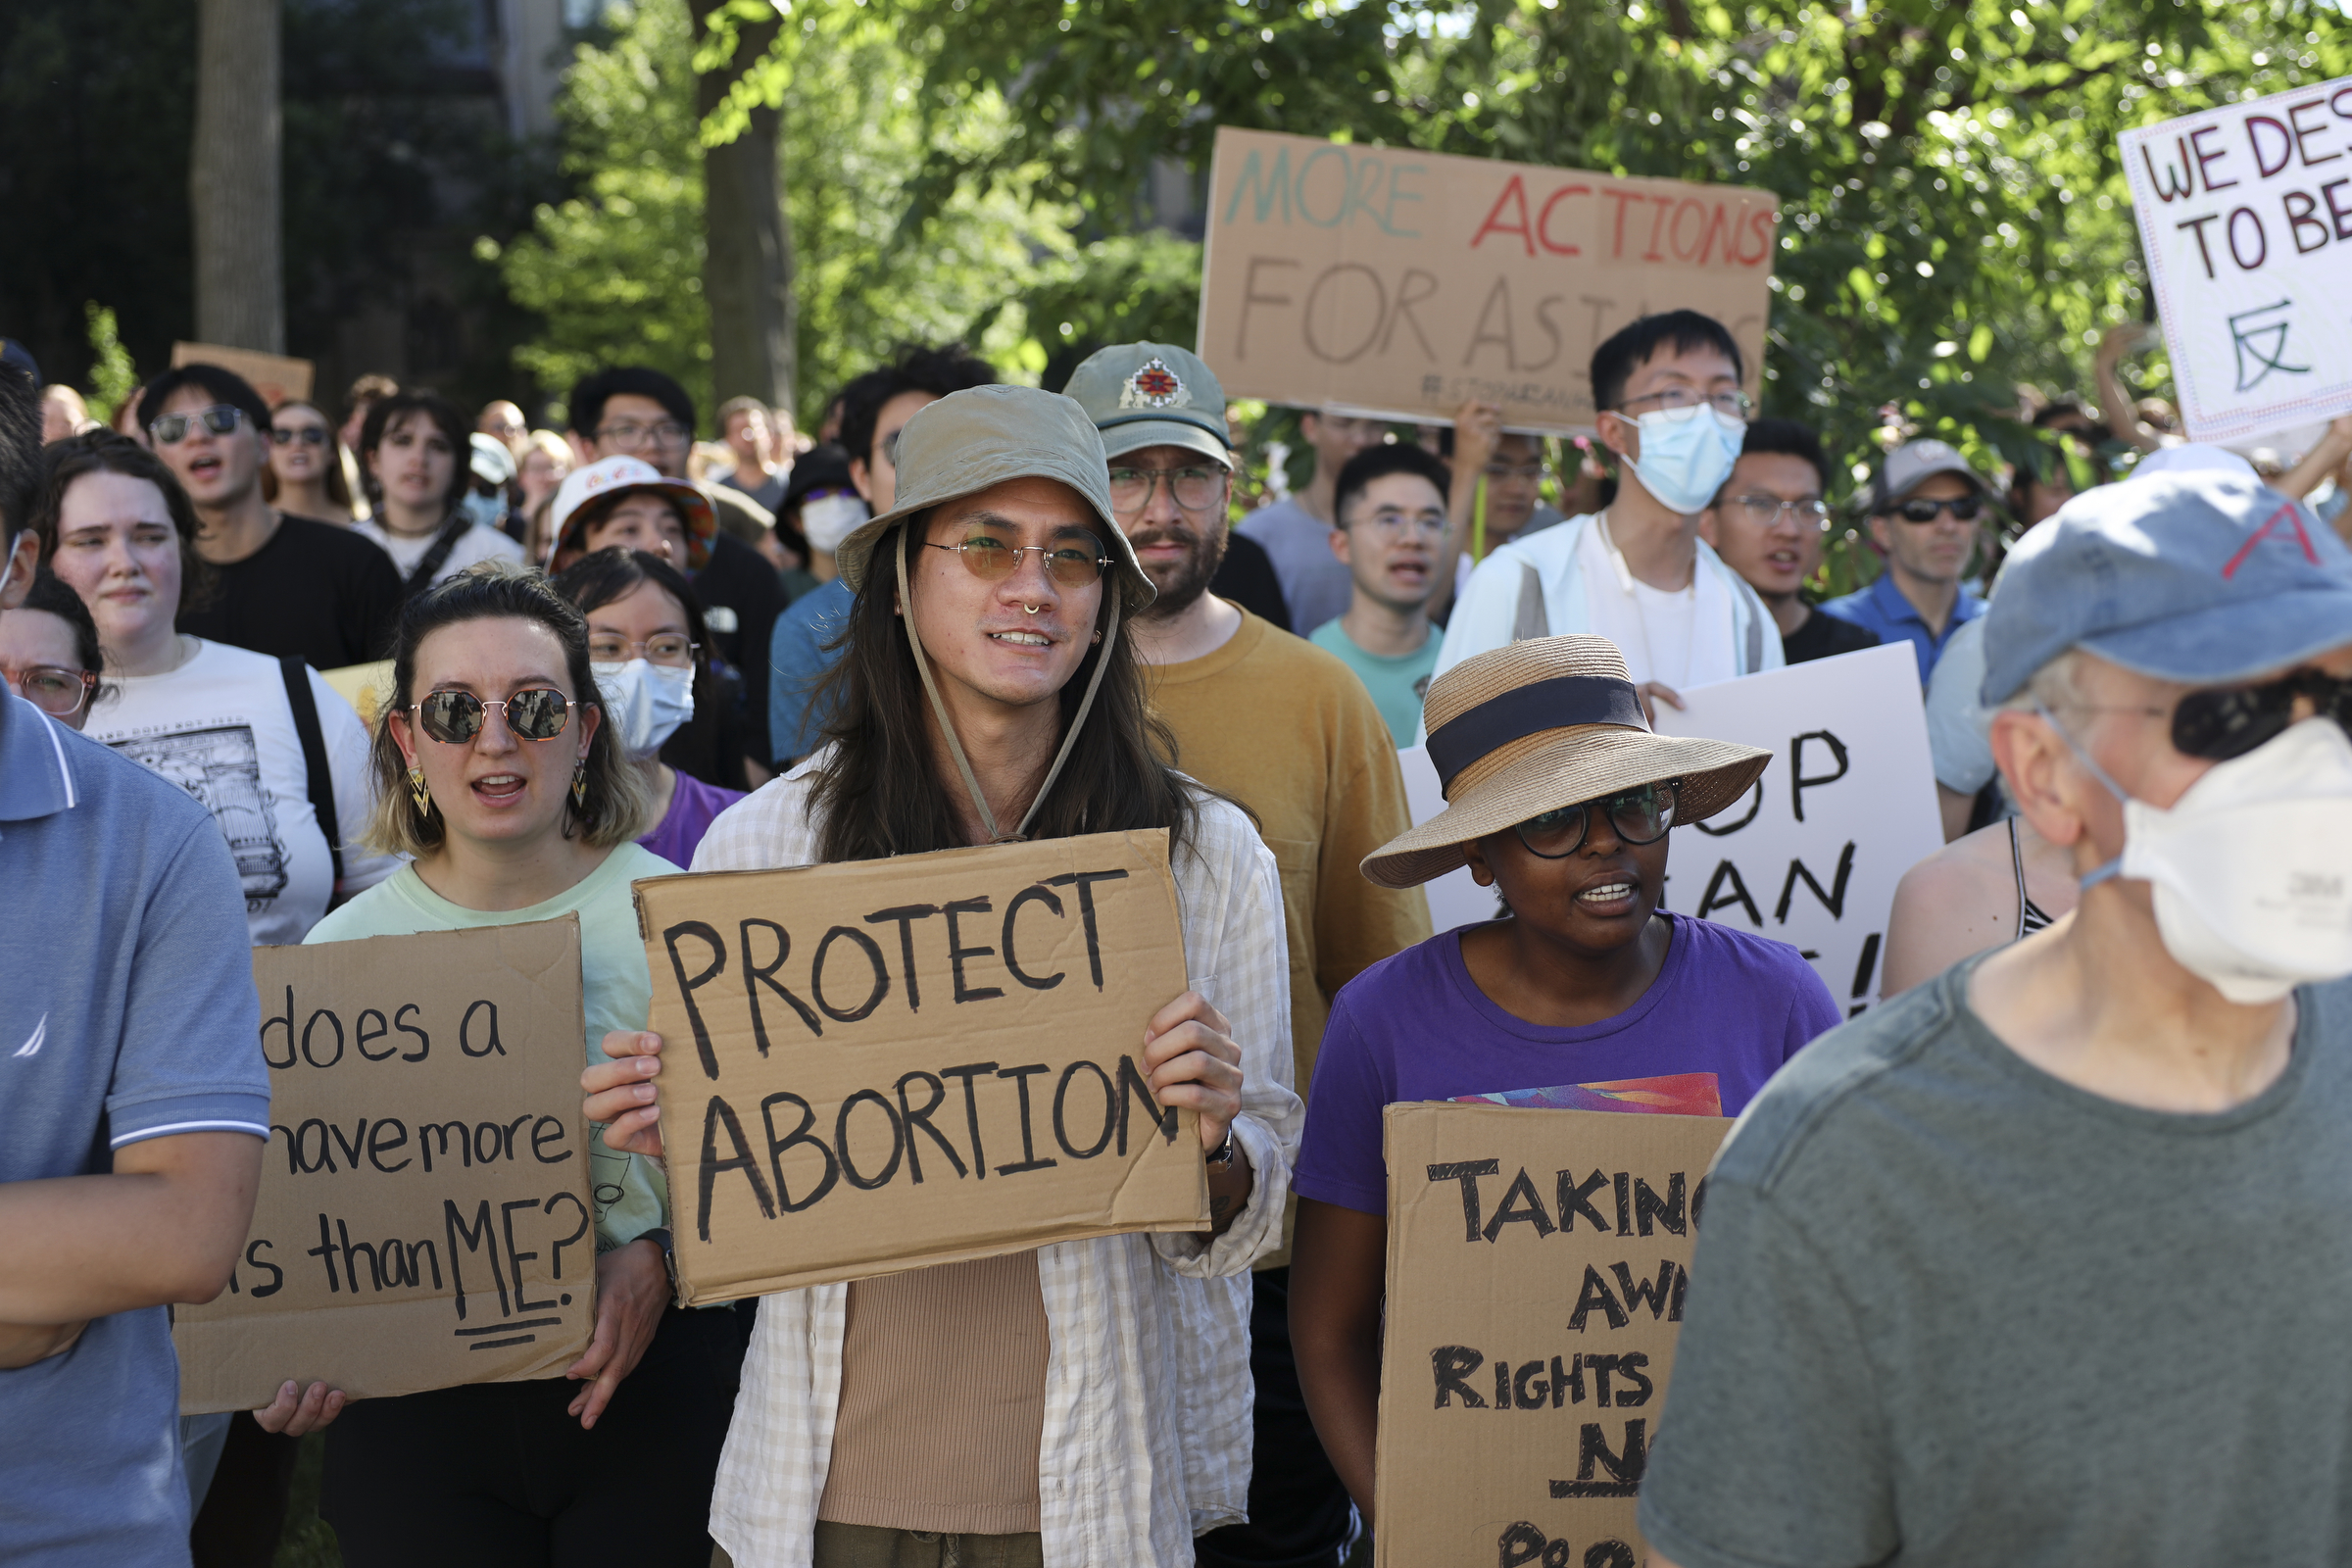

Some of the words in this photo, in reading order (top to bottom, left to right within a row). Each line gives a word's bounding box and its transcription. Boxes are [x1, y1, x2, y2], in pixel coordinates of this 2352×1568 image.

[1224, 144, 1427, 238] MORE
[1470, 172, 1776, 269] ACTIONS
[2140, 124, 2240, 203] WE
[2177, 207, 2267, 279] TO
[2282, 178, 2352, 255] BE
[1234, 254, 1439, 365] FOR
[2228, 298, 2313, 394] 反
[2222, 502, 2325, 581] A
[663, 868, 1129, 1080] PROTECT
[260, 984, 430, 1069] does
[459, 1000, 508, 1057] a
[418, 1113, 573, 1173] more
[696, 1054, 1180, 1244] ABORTION
[308, 1213, 444, 1295] than
[444, 1192, 589, 1321] ME?
